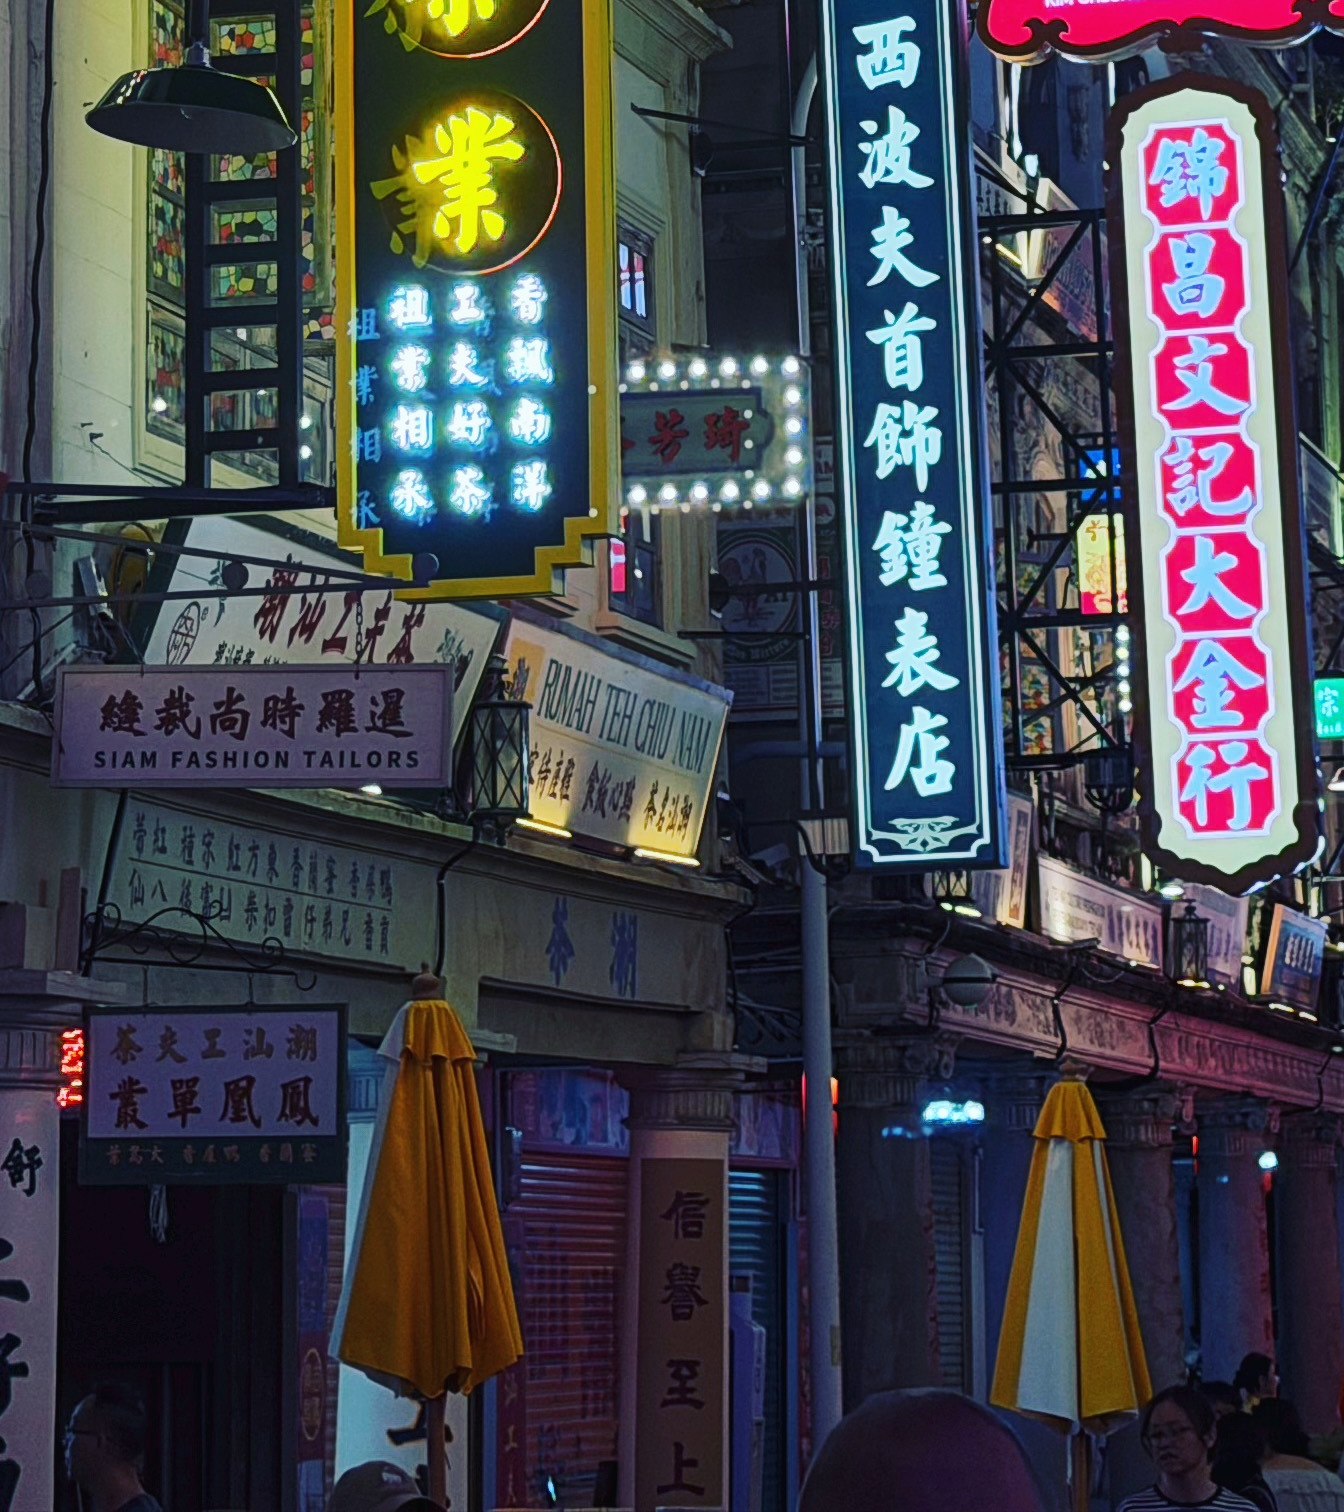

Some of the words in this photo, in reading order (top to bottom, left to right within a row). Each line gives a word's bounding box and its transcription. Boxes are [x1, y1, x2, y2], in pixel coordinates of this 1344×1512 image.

[622, 405, 751, 465] 琦芳
[1148, 127, 1270, 831] 錦昌文記大金行
[94, 749, 158, 770] SIAM
[171, 749, 290, 770] FASHION
[304, 749, 421, 770] TAILORS
[537, 658, 603, 735] RUMAH
[598, 682, 638, 749] TEH
[634, 697, 678, 762] CHIU
[671, 709, 712, 775] NAM
